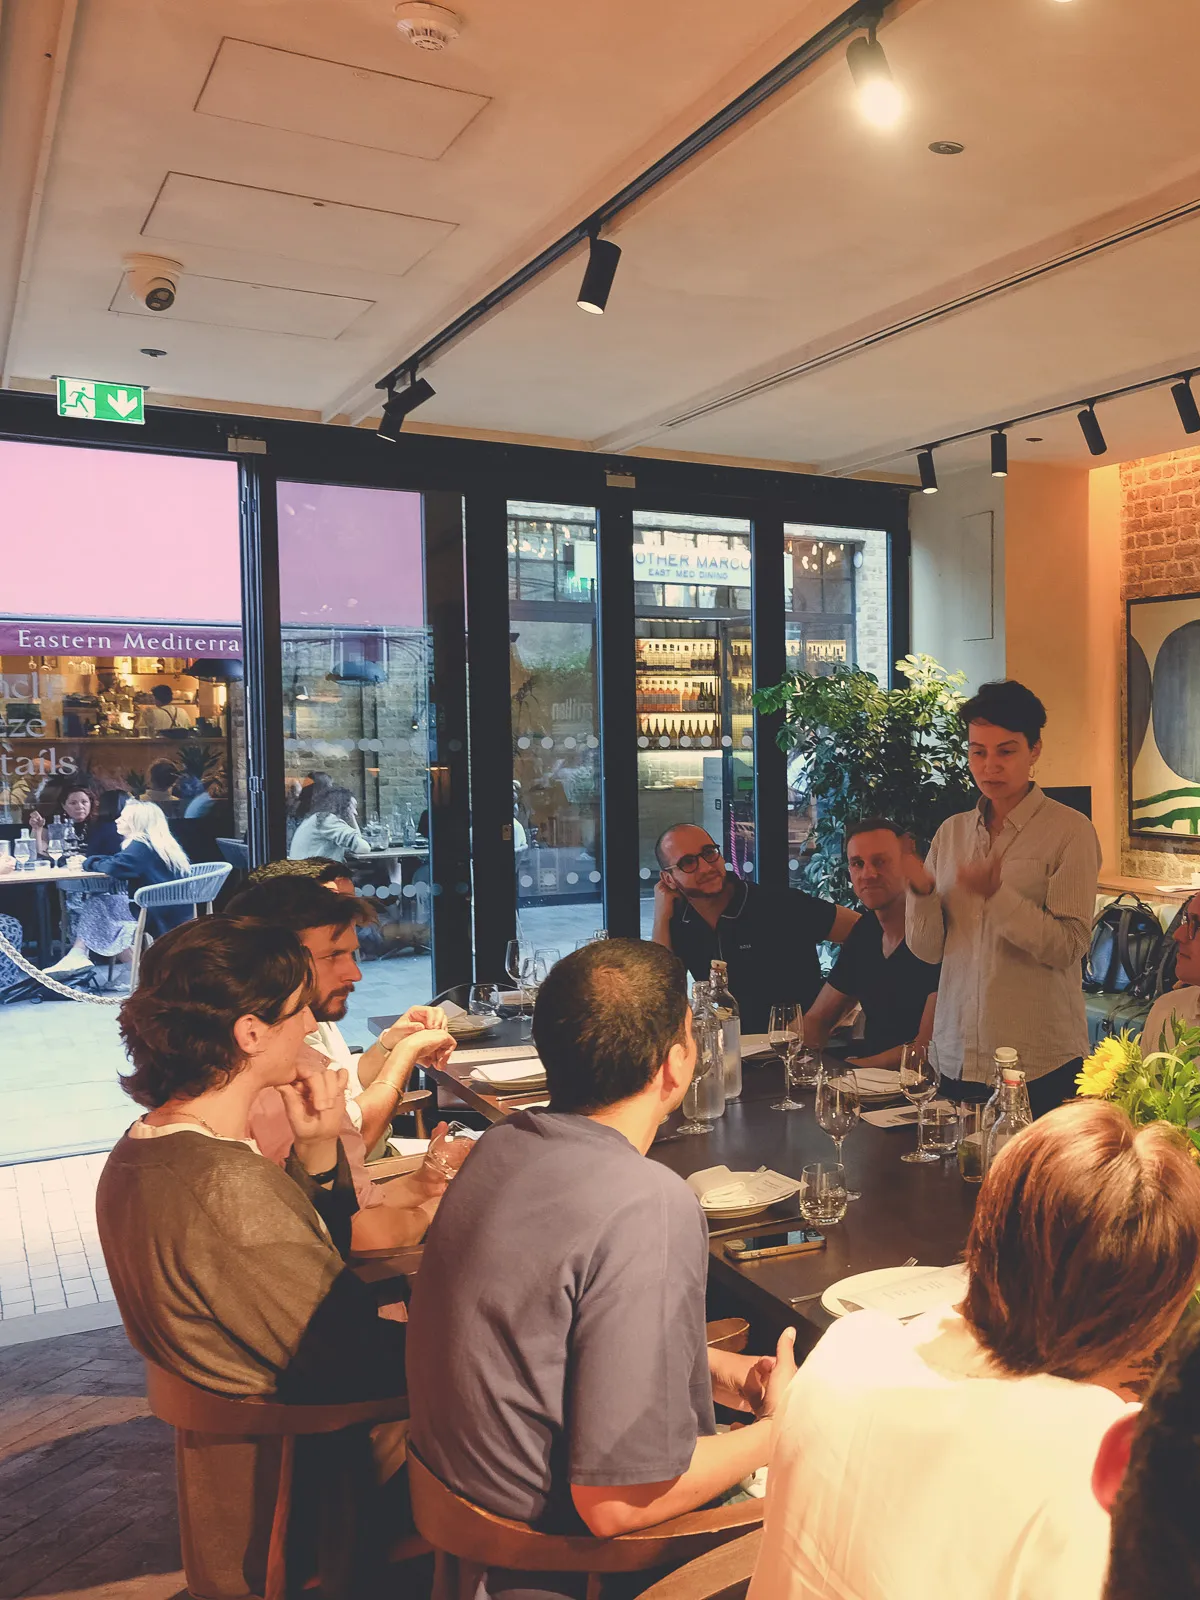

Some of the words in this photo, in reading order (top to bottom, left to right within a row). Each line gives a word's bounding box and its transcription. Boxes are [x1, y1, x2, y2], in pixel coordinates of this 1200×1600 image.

[648, 568, 671, 577] EAST
[675, 569, 695, 578] MED
[699, 571, 728, 580] DINING
[17, 629, 112, 649] Eastern
